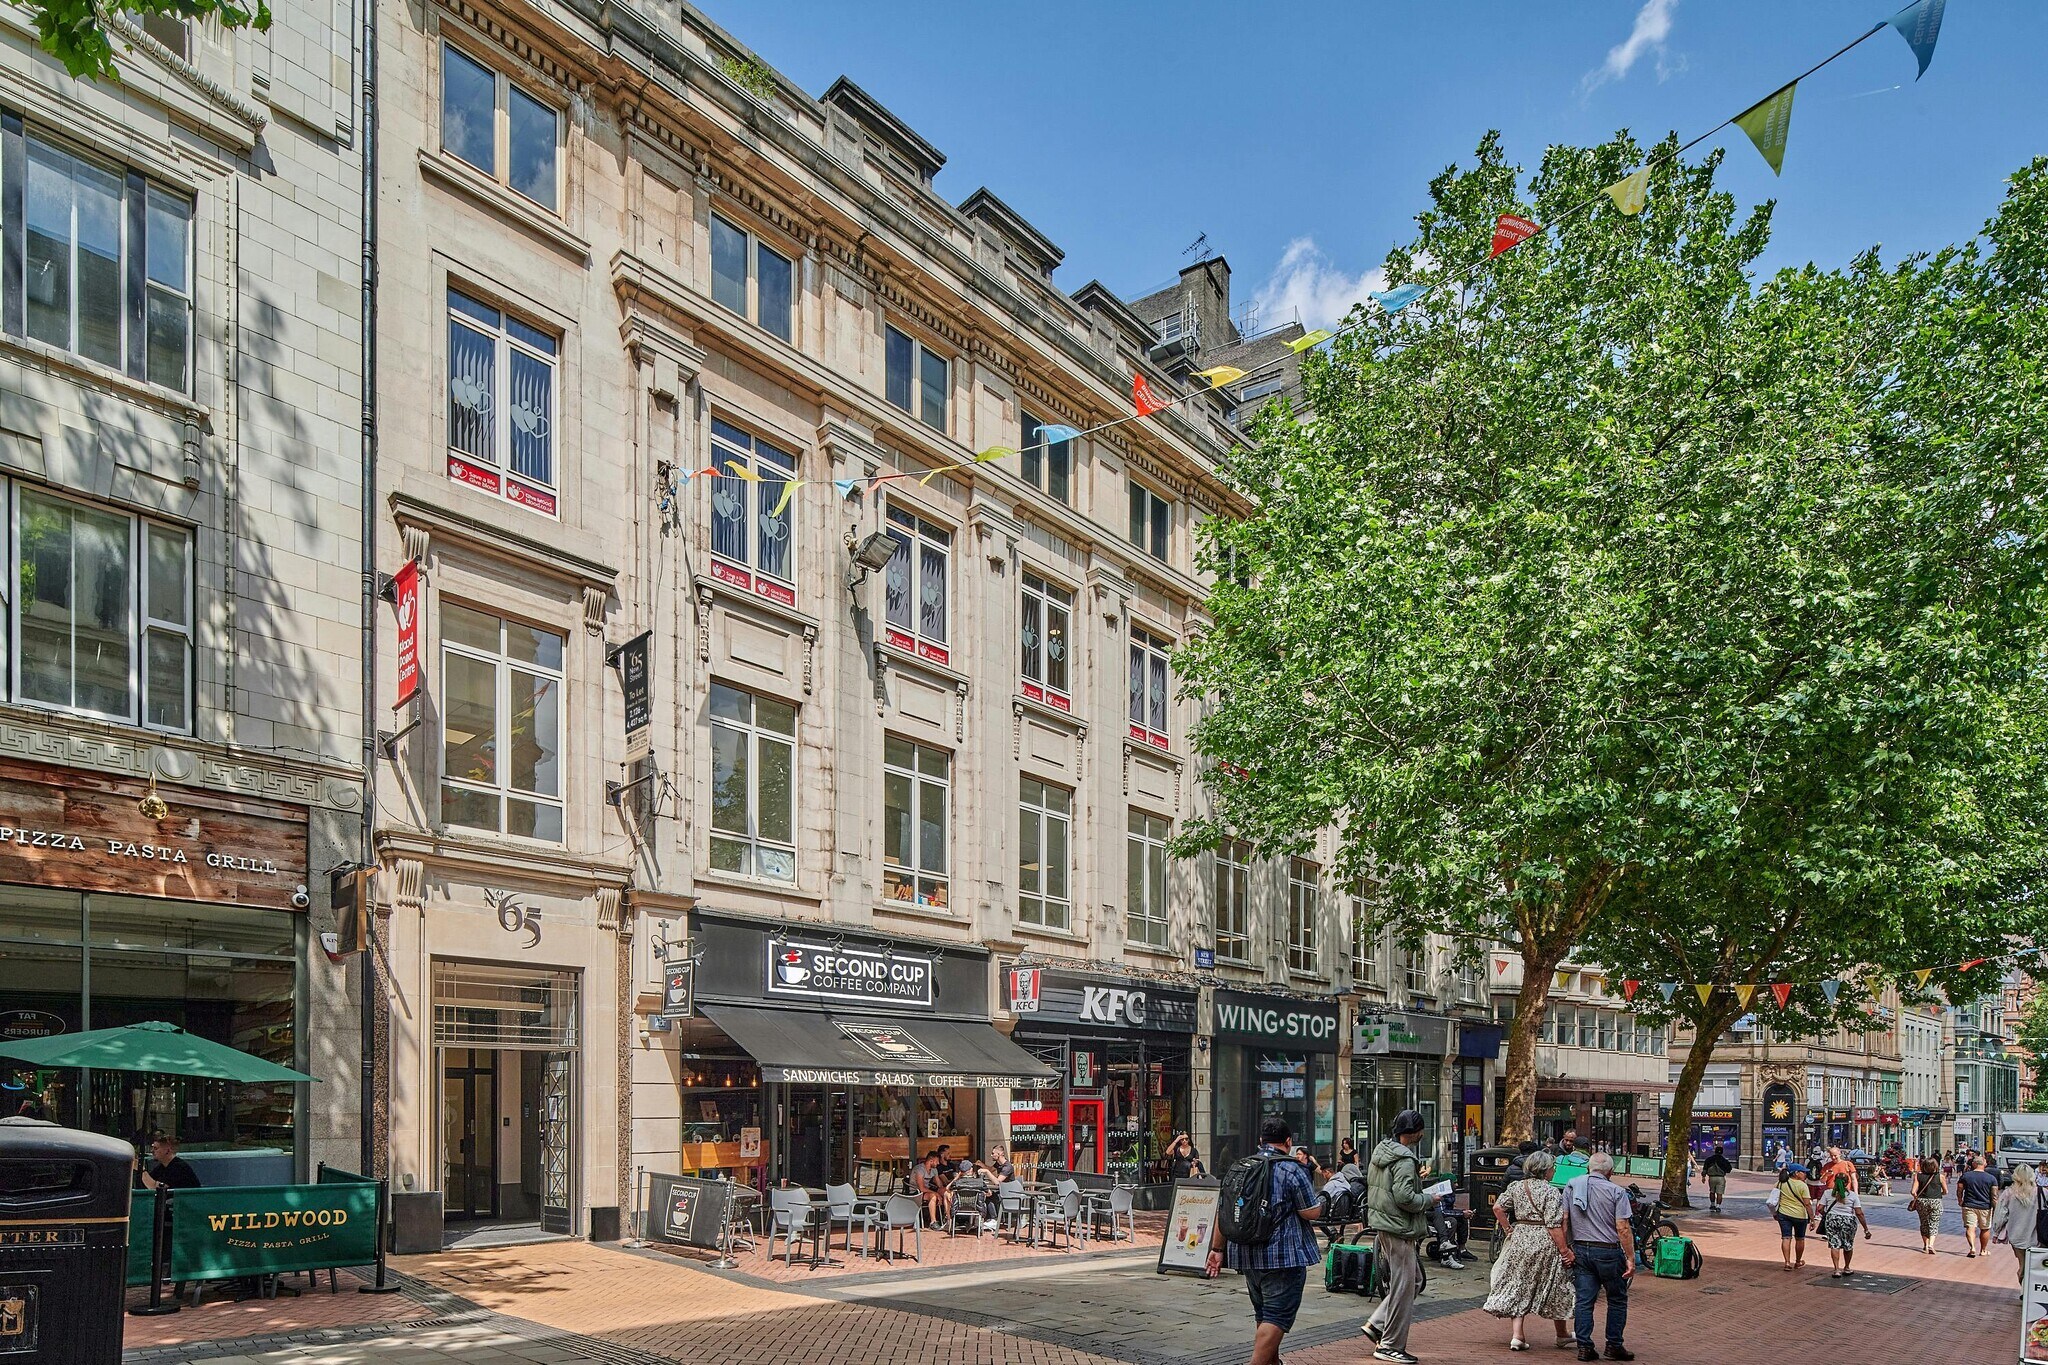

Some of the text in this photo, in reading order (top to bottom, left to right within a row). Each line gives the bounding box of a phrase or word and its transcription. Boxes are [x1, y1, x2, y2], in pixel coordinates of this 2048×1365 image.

[469, 471, 482, 480] Save
[469, 477, 498, 492] Give blood
[0, 827, 277, 874] PIZZA PASTA GRILL
[813, 954, 925, 983] SECOND CUP
[813, 975, 923, 997] COFFEE COMPANY
[1015, 1001, 1035, 1011] KFC
[1079, 986, 1146, 1025] KFC
[782, 1068, 1048, 1088] SANDWICHES SALADS COFFEE PATISSERIE TEA
[1011, 1100, 1042, 1111] HELLO
[208, 1209, 348, 1232] WILDWOOD
[226, 1232, 330, 1249] PIZZA PASTA GRILL
